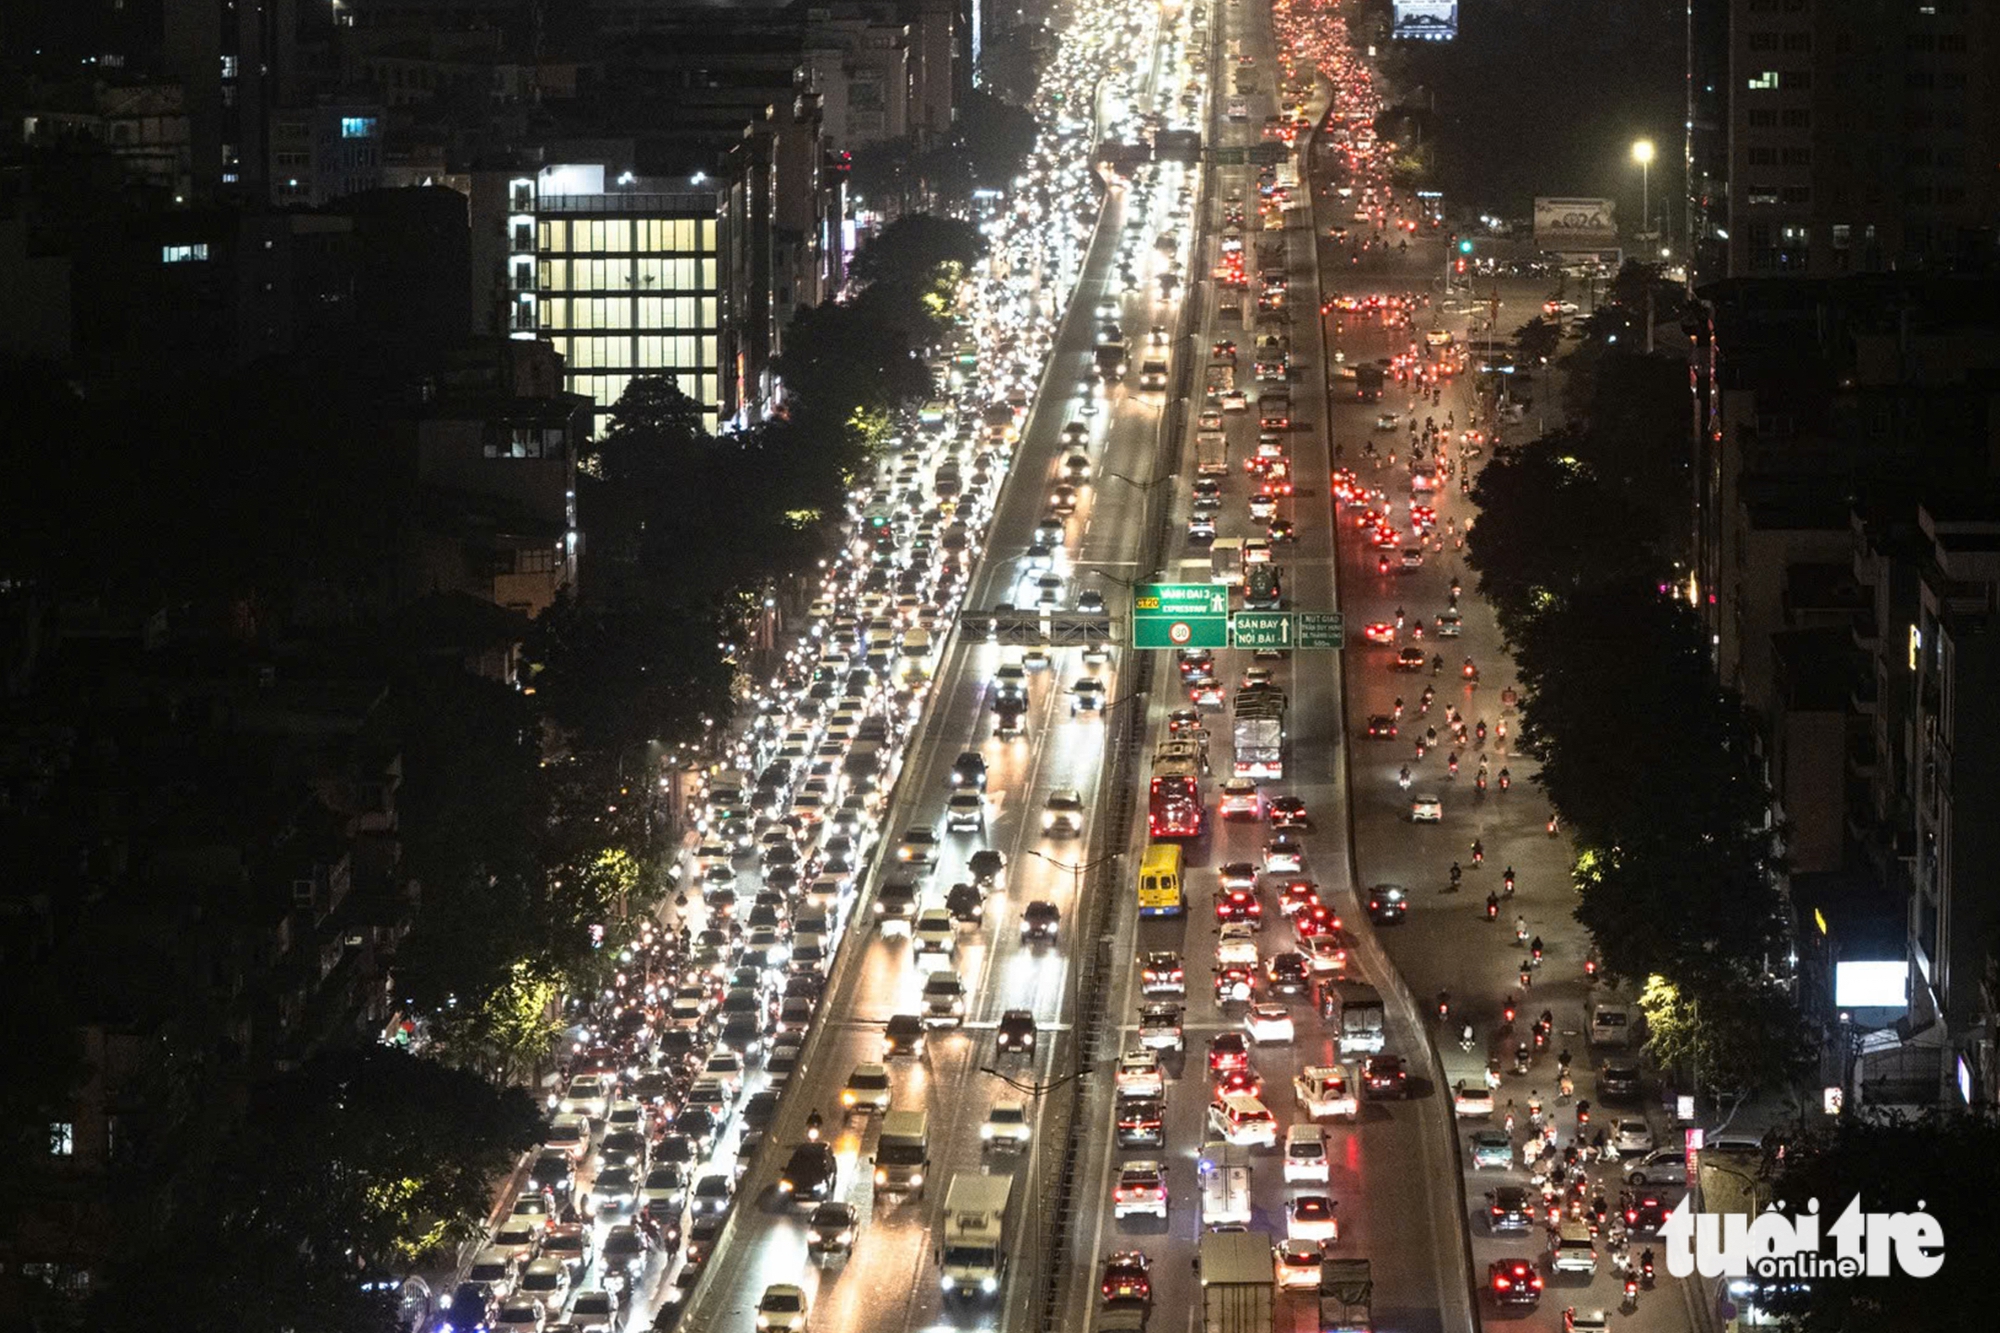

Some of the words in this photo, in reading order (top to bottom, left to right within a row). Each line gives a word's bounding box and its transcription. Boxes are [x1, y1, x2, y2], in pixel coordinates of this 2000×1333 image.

[1204, 589, 1210, 599] 3
[1260, 619, 1279, 629] BAY
[1175, 627, 1187, 638] 80
[1258, 632, 1275, 643] BÀI
